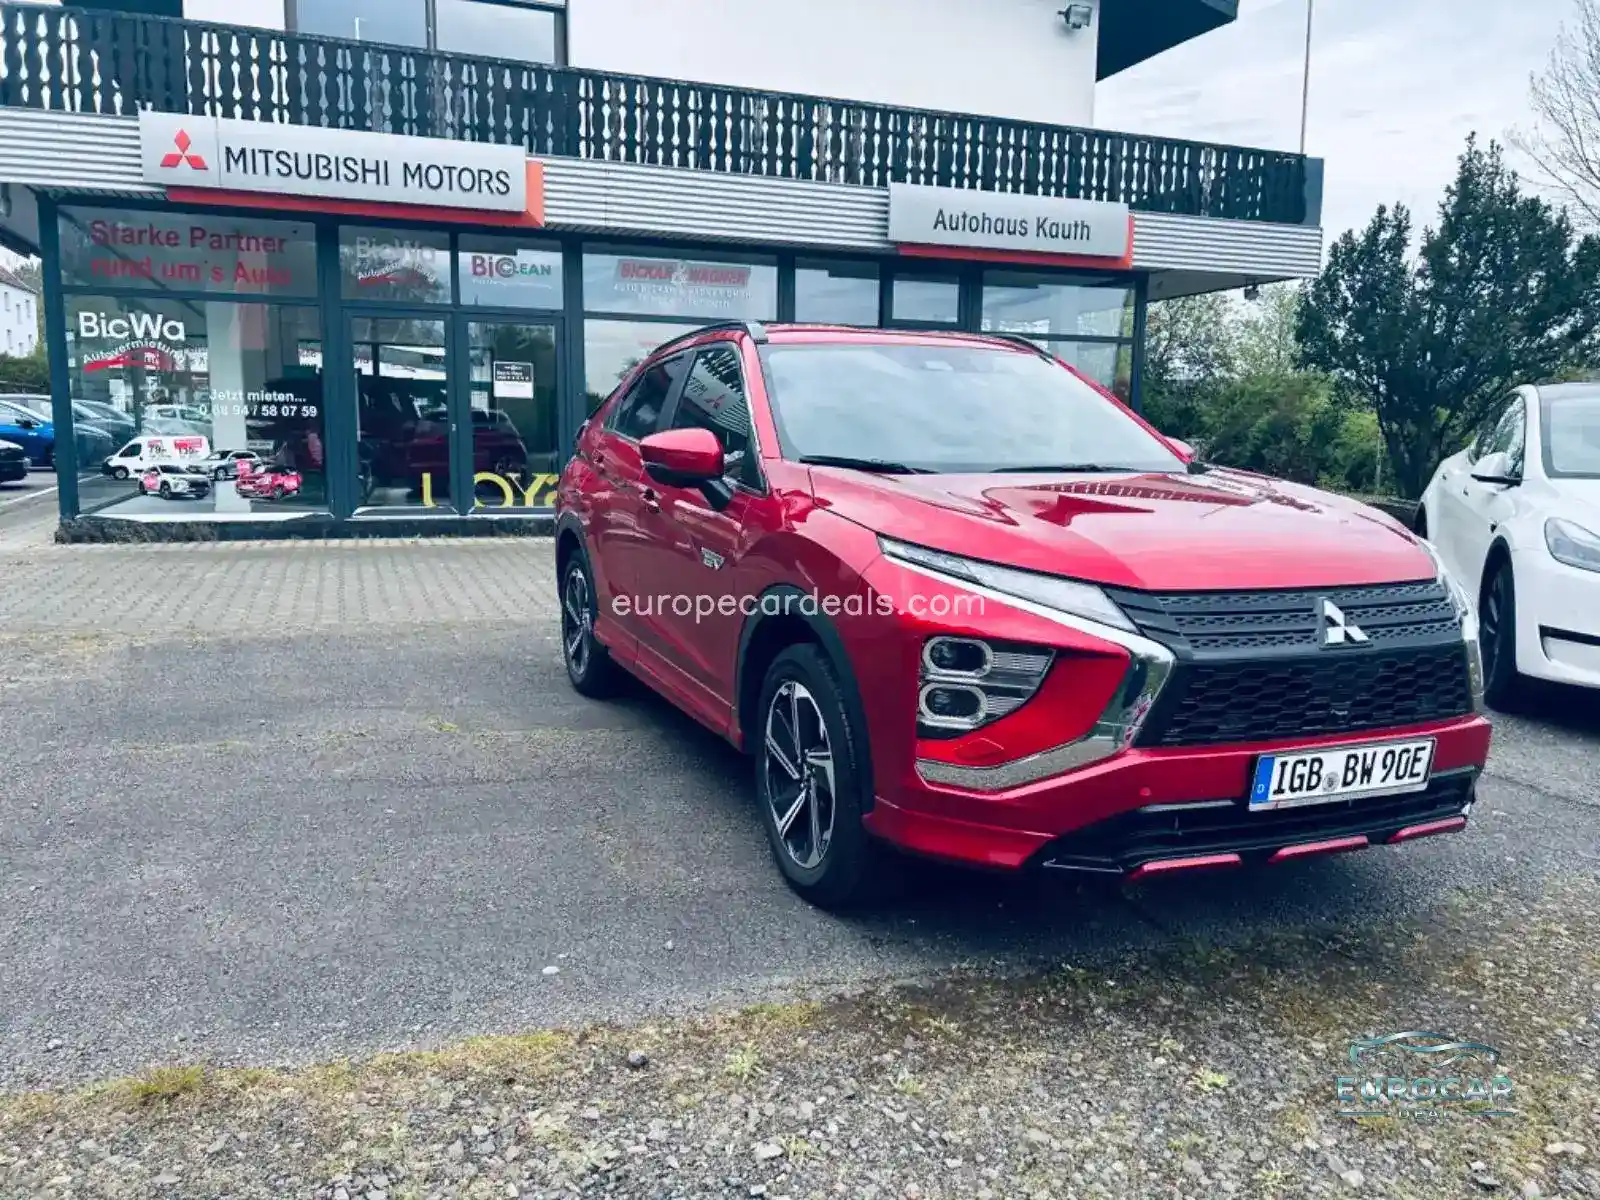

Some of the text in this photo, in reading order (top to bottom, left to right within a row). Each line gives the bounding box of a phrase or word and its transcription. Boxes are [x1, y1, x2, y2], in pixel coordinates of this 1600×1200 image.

[224, 146, 512, 196] MITSUBISHI MOTORS
[90, 219, 287, 253] Starke Partner
[932, 207, 1091, 242] Autohaus Kauth
[90, 256, 153, 278] rund
[233, 260, 293, 285] Auto
[77, 311, 186, 342] BicWa
[208, 388, 244, 402] Jetzt
[261, 405, 278, 417] 58
[281, 406, 297, 418] 07
[301, 406, 318, 418] 59
[1272, 745, 1426, 796] IGB BW 90E
